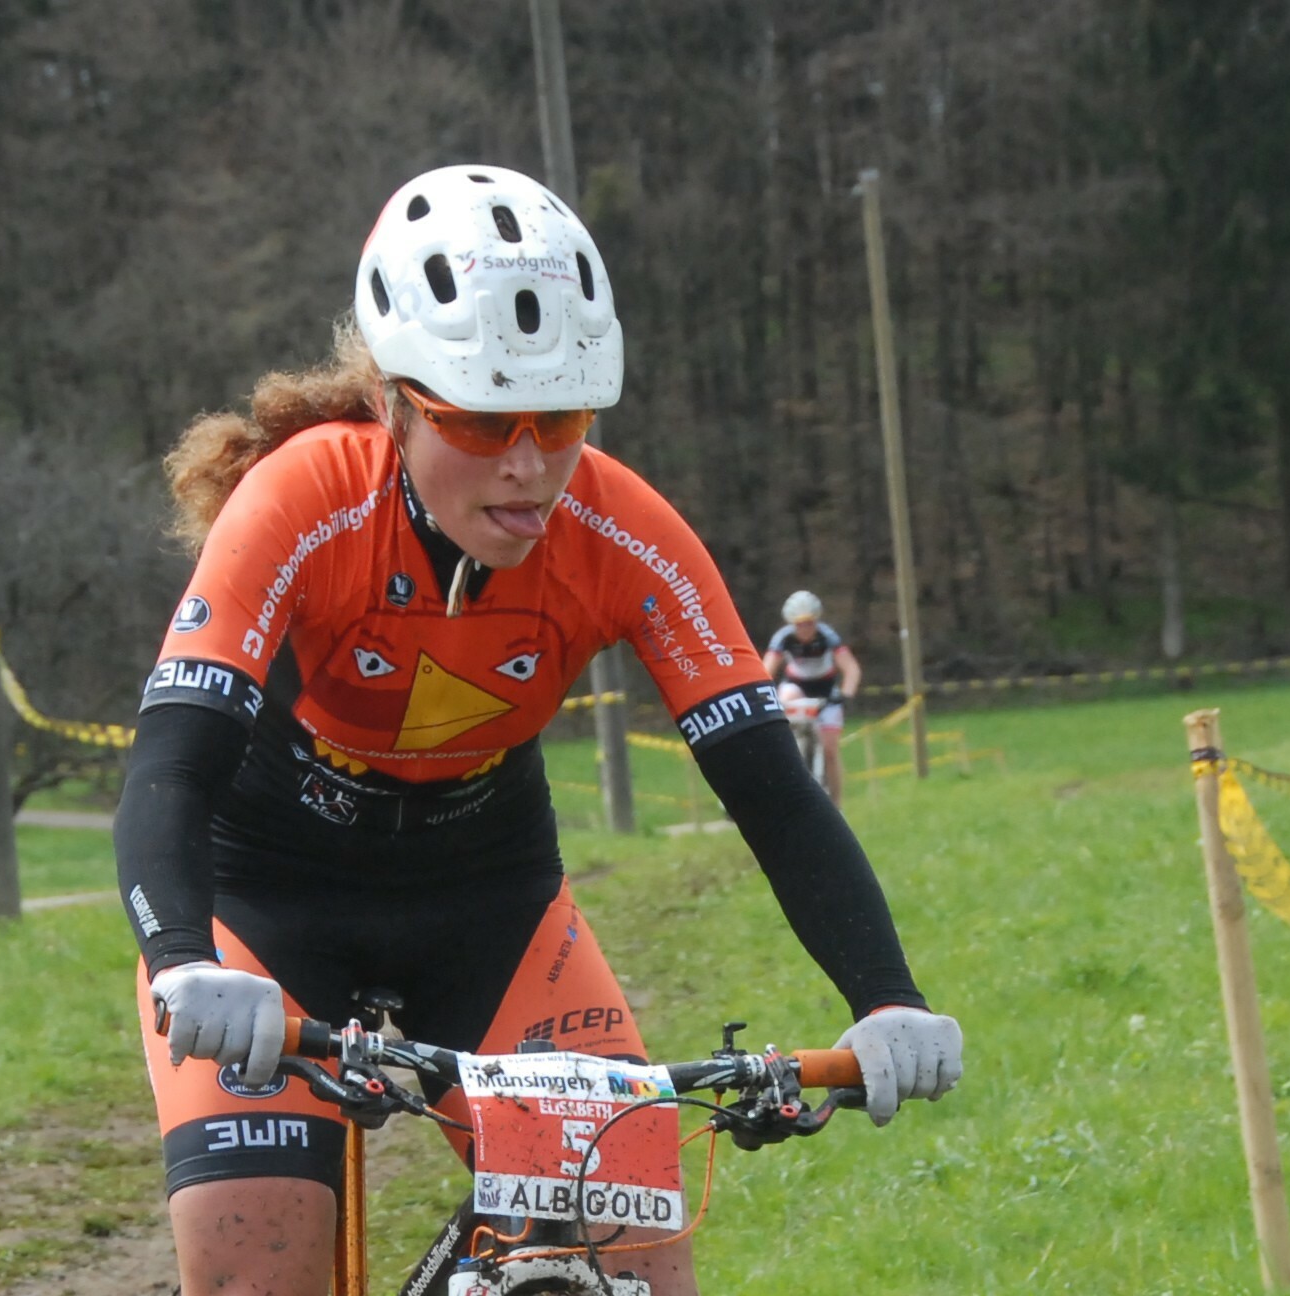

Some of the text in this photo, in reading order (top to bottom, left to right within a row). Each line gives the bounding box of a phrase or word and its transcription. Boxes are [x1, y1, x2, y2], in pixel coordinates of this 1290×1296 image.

[257, 474, 395, 634] notebooksbilliger.
[558, 490, 734, 667] notebooksbilliger.de
[560, 1119, 601, 1176] 5
